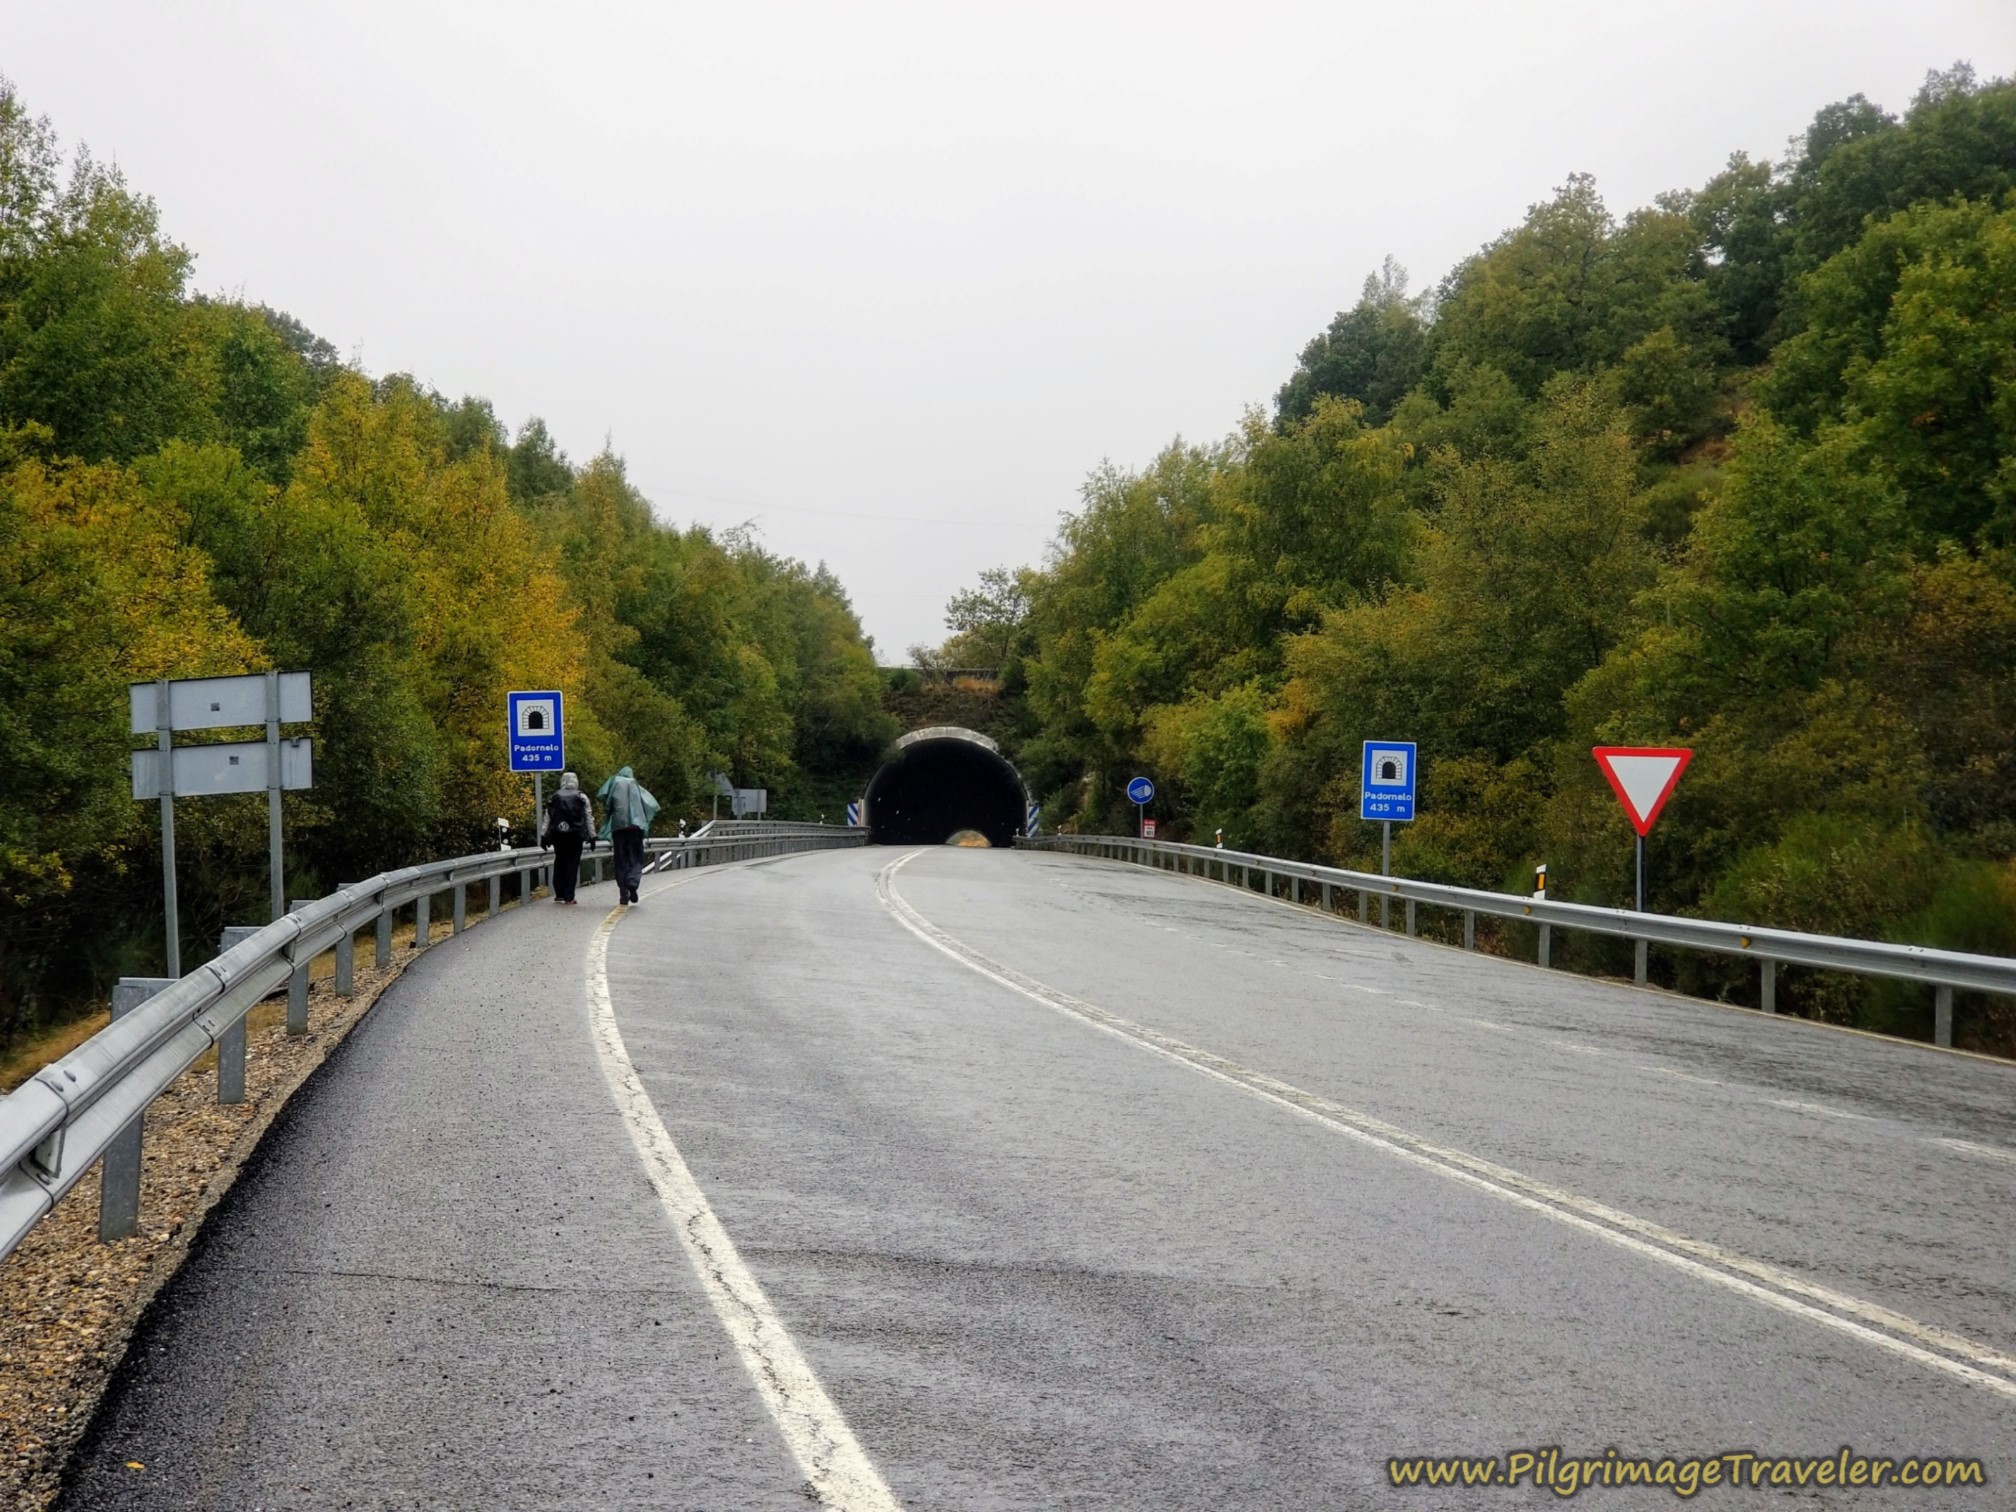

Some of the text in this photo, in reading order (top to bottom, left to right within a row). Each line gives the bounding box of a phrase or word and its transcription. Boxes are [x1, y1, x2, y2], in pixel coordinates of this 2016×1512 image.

[514, 744, 559, 752] Padornelo
[522, 754, 540, 762] 435
[1364, 791, 1412, 801] Padornelo
[1370, 803, 1406, 813] 435 m
